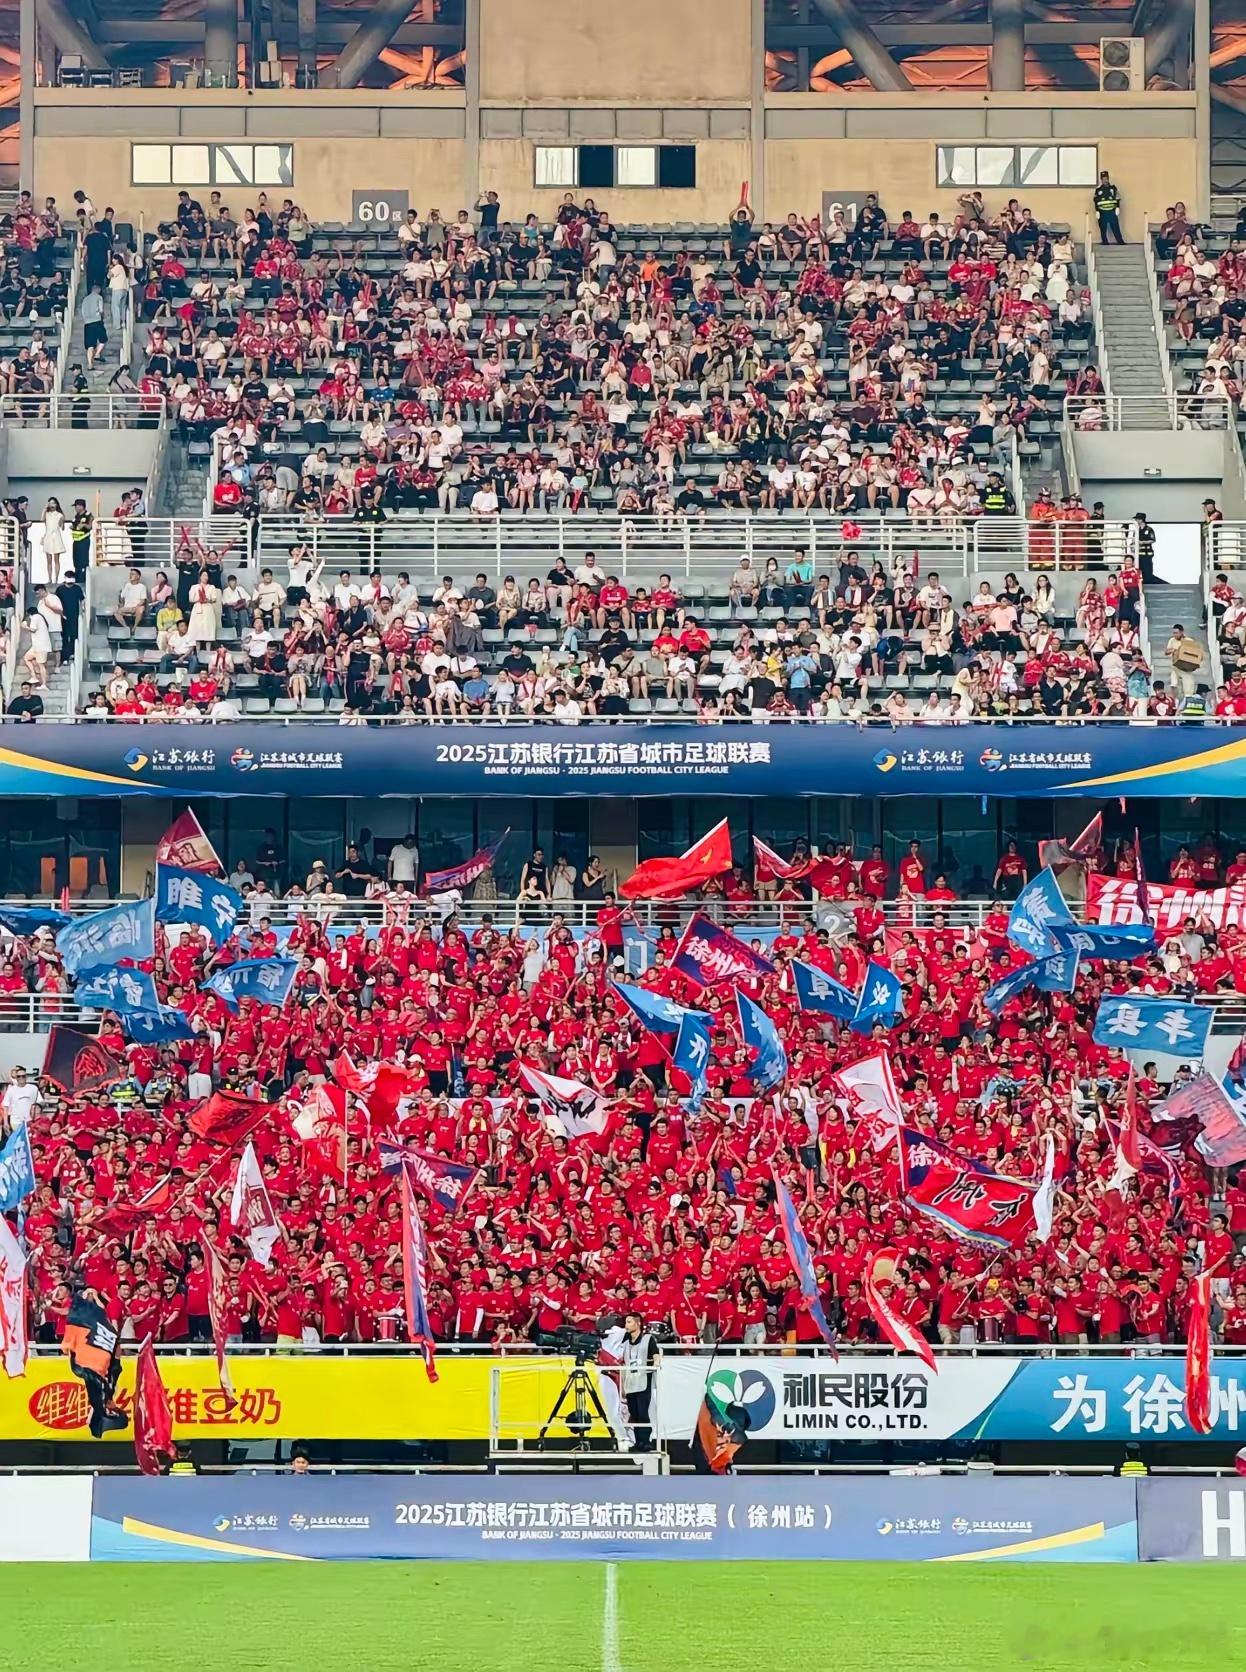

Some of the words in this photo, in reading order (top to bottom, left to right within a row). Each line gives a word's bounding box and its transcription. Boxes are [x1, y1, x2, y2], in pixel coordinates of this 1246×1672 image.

[152, 748, 216, 764] 江苏银行
[436, 742, 771, 764] 2025江苏银行江苏省城市足球联赛
[901, 748, 965, 765] 江苏银行
[484, 766, 508, 775] BANK
[510, 766, 523, 775] OF
[524, 766, 560, 776] JIANGSU
[568, 766, 589, 775] 2025
[590, 766, 626, 776] JIANGSU
[627, 766, 672, 774] FOOTBALL
[673, 766, 694, 774] CITY
[695, 766, 729, 774] LEAGUE
[783, 1373, 928, 1409] 利民股份
[784, 1414, 838, 1428] LIMIN
[845, 1414, 928, 1431] CO.,LTD.
[482, 1531, 505, 1539] BANK
[507, 1531, 518, 1539] OF
[519, 1531, 554, 1540] JIANGSU
[560, 1531, 581, 1539] 2025
[582, 1531, 616, 1540] JIANGSU
[617, 1531, 659, 1539] FOOTBALL
[661, 1531, 679, 1539] CITY
[680, 1531, 713, 1540] LEAGUE
